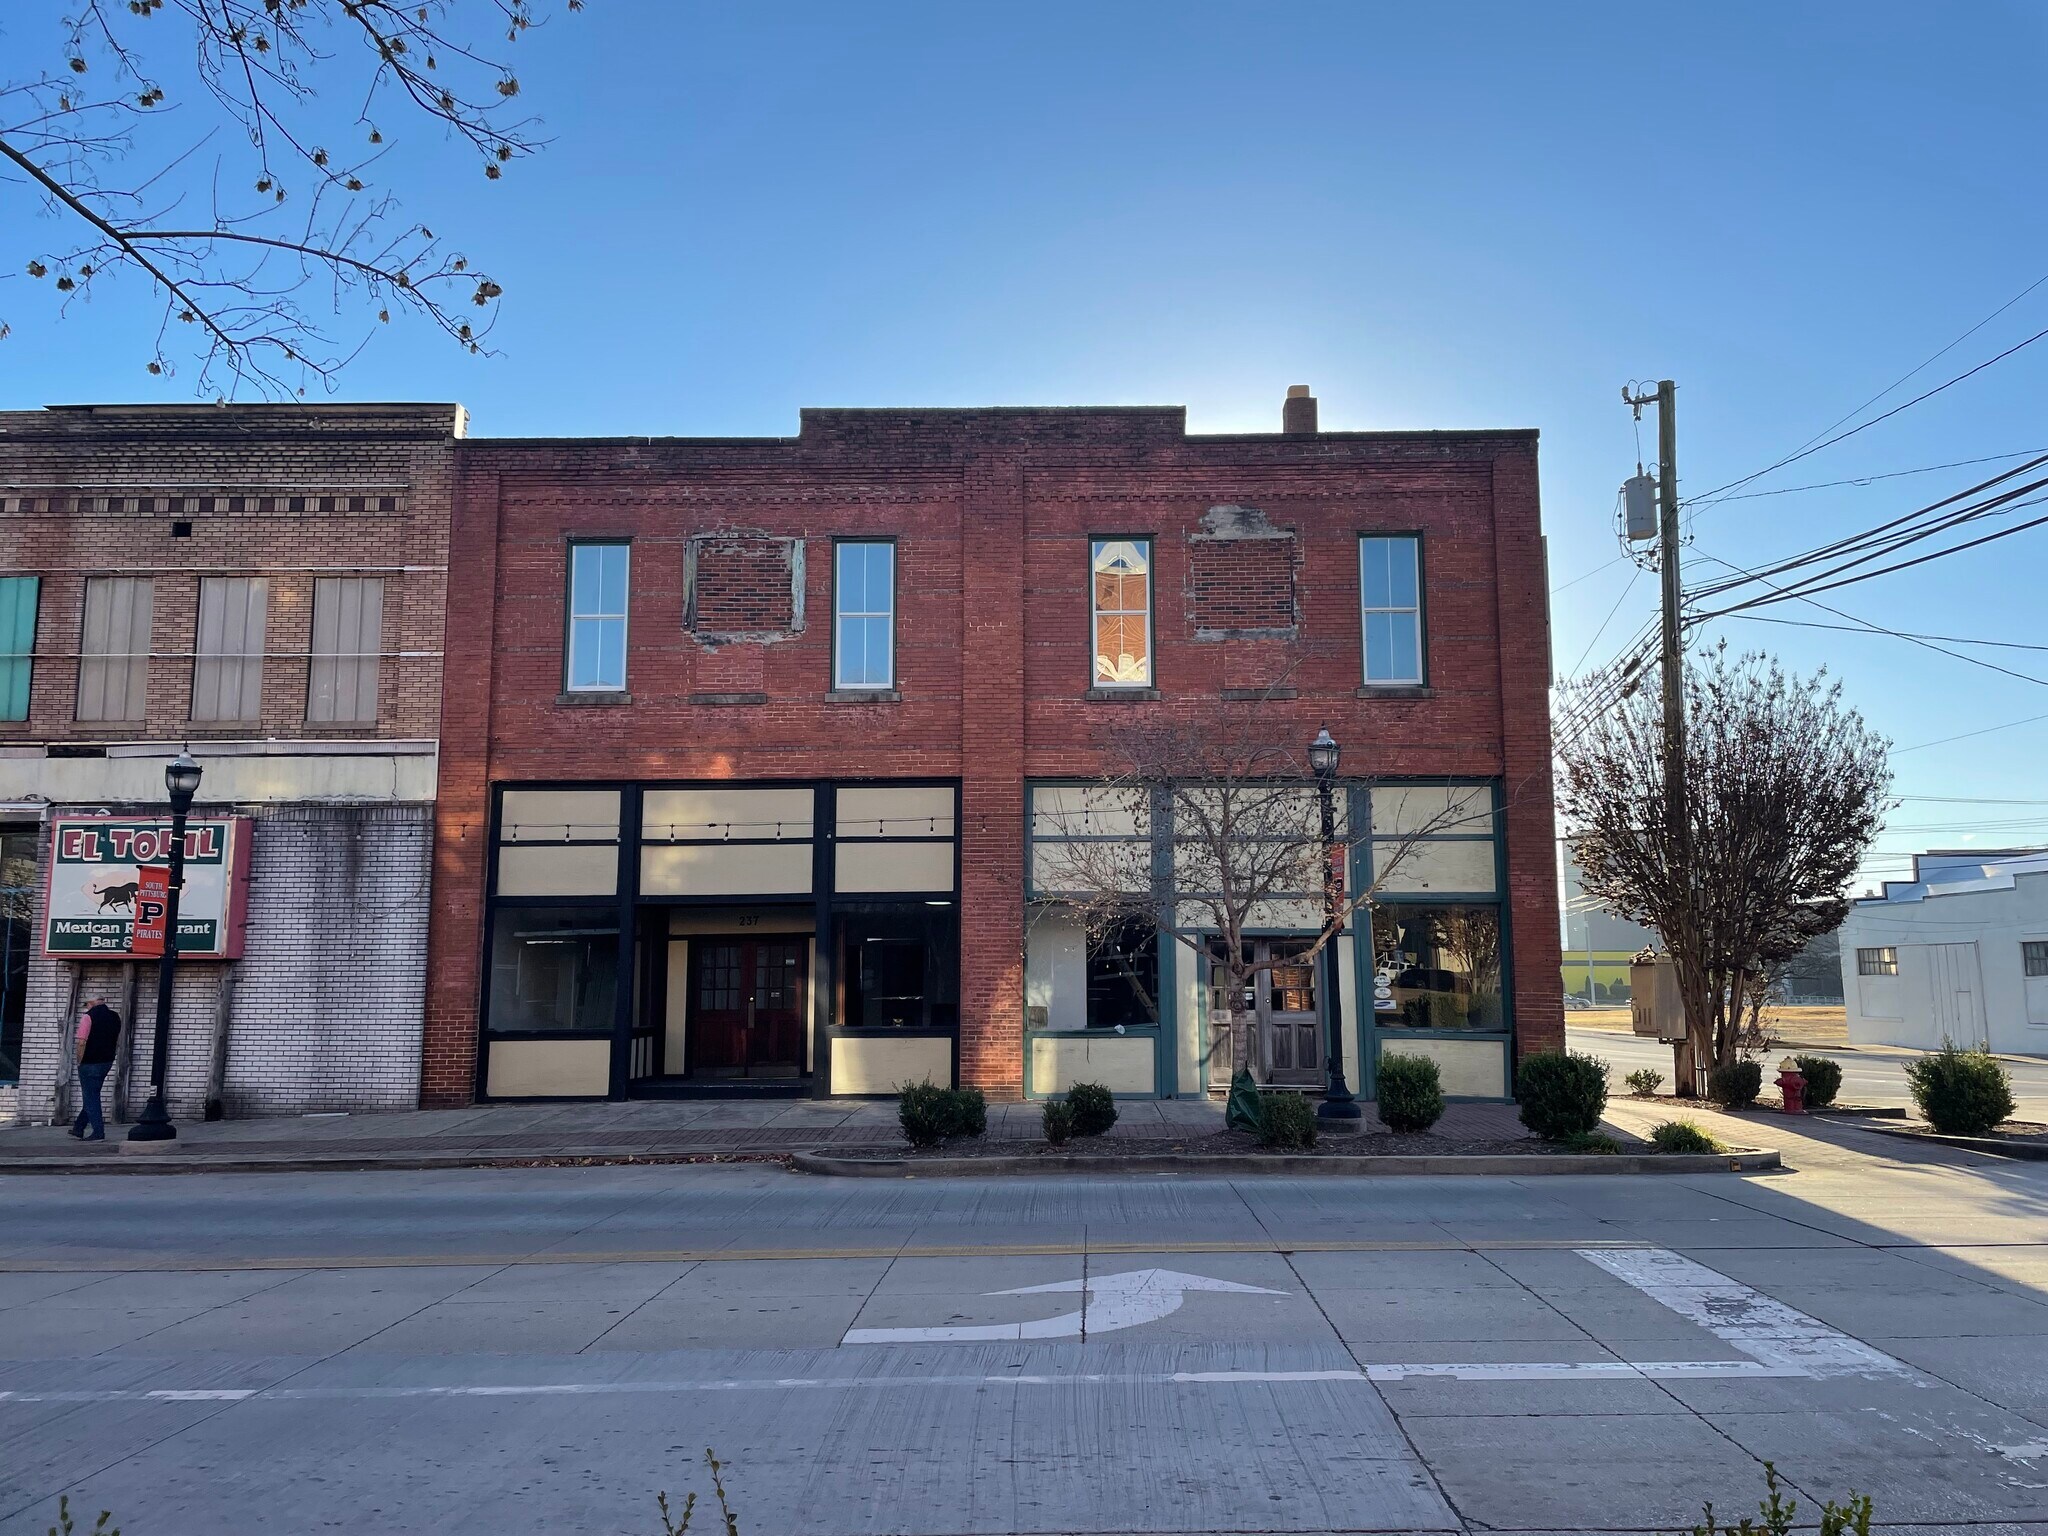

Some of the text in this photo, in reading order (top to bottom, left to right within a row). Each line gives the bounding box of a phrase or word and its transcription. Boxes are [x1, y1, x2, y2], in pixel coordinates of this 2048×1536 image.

[62, 829, 102, 861] EL
[145, 881, 163, 890] SOUTH
[139, 889, 167, 899] PITTSBURG
[138, 900, 165, 926] P
[739, 915, 760, 926] 237
[55, 921, 211, 934] Mexican Rrant
[136, 929, 163, 939] PIRATES
[90, 936, 119, 948] Bar
